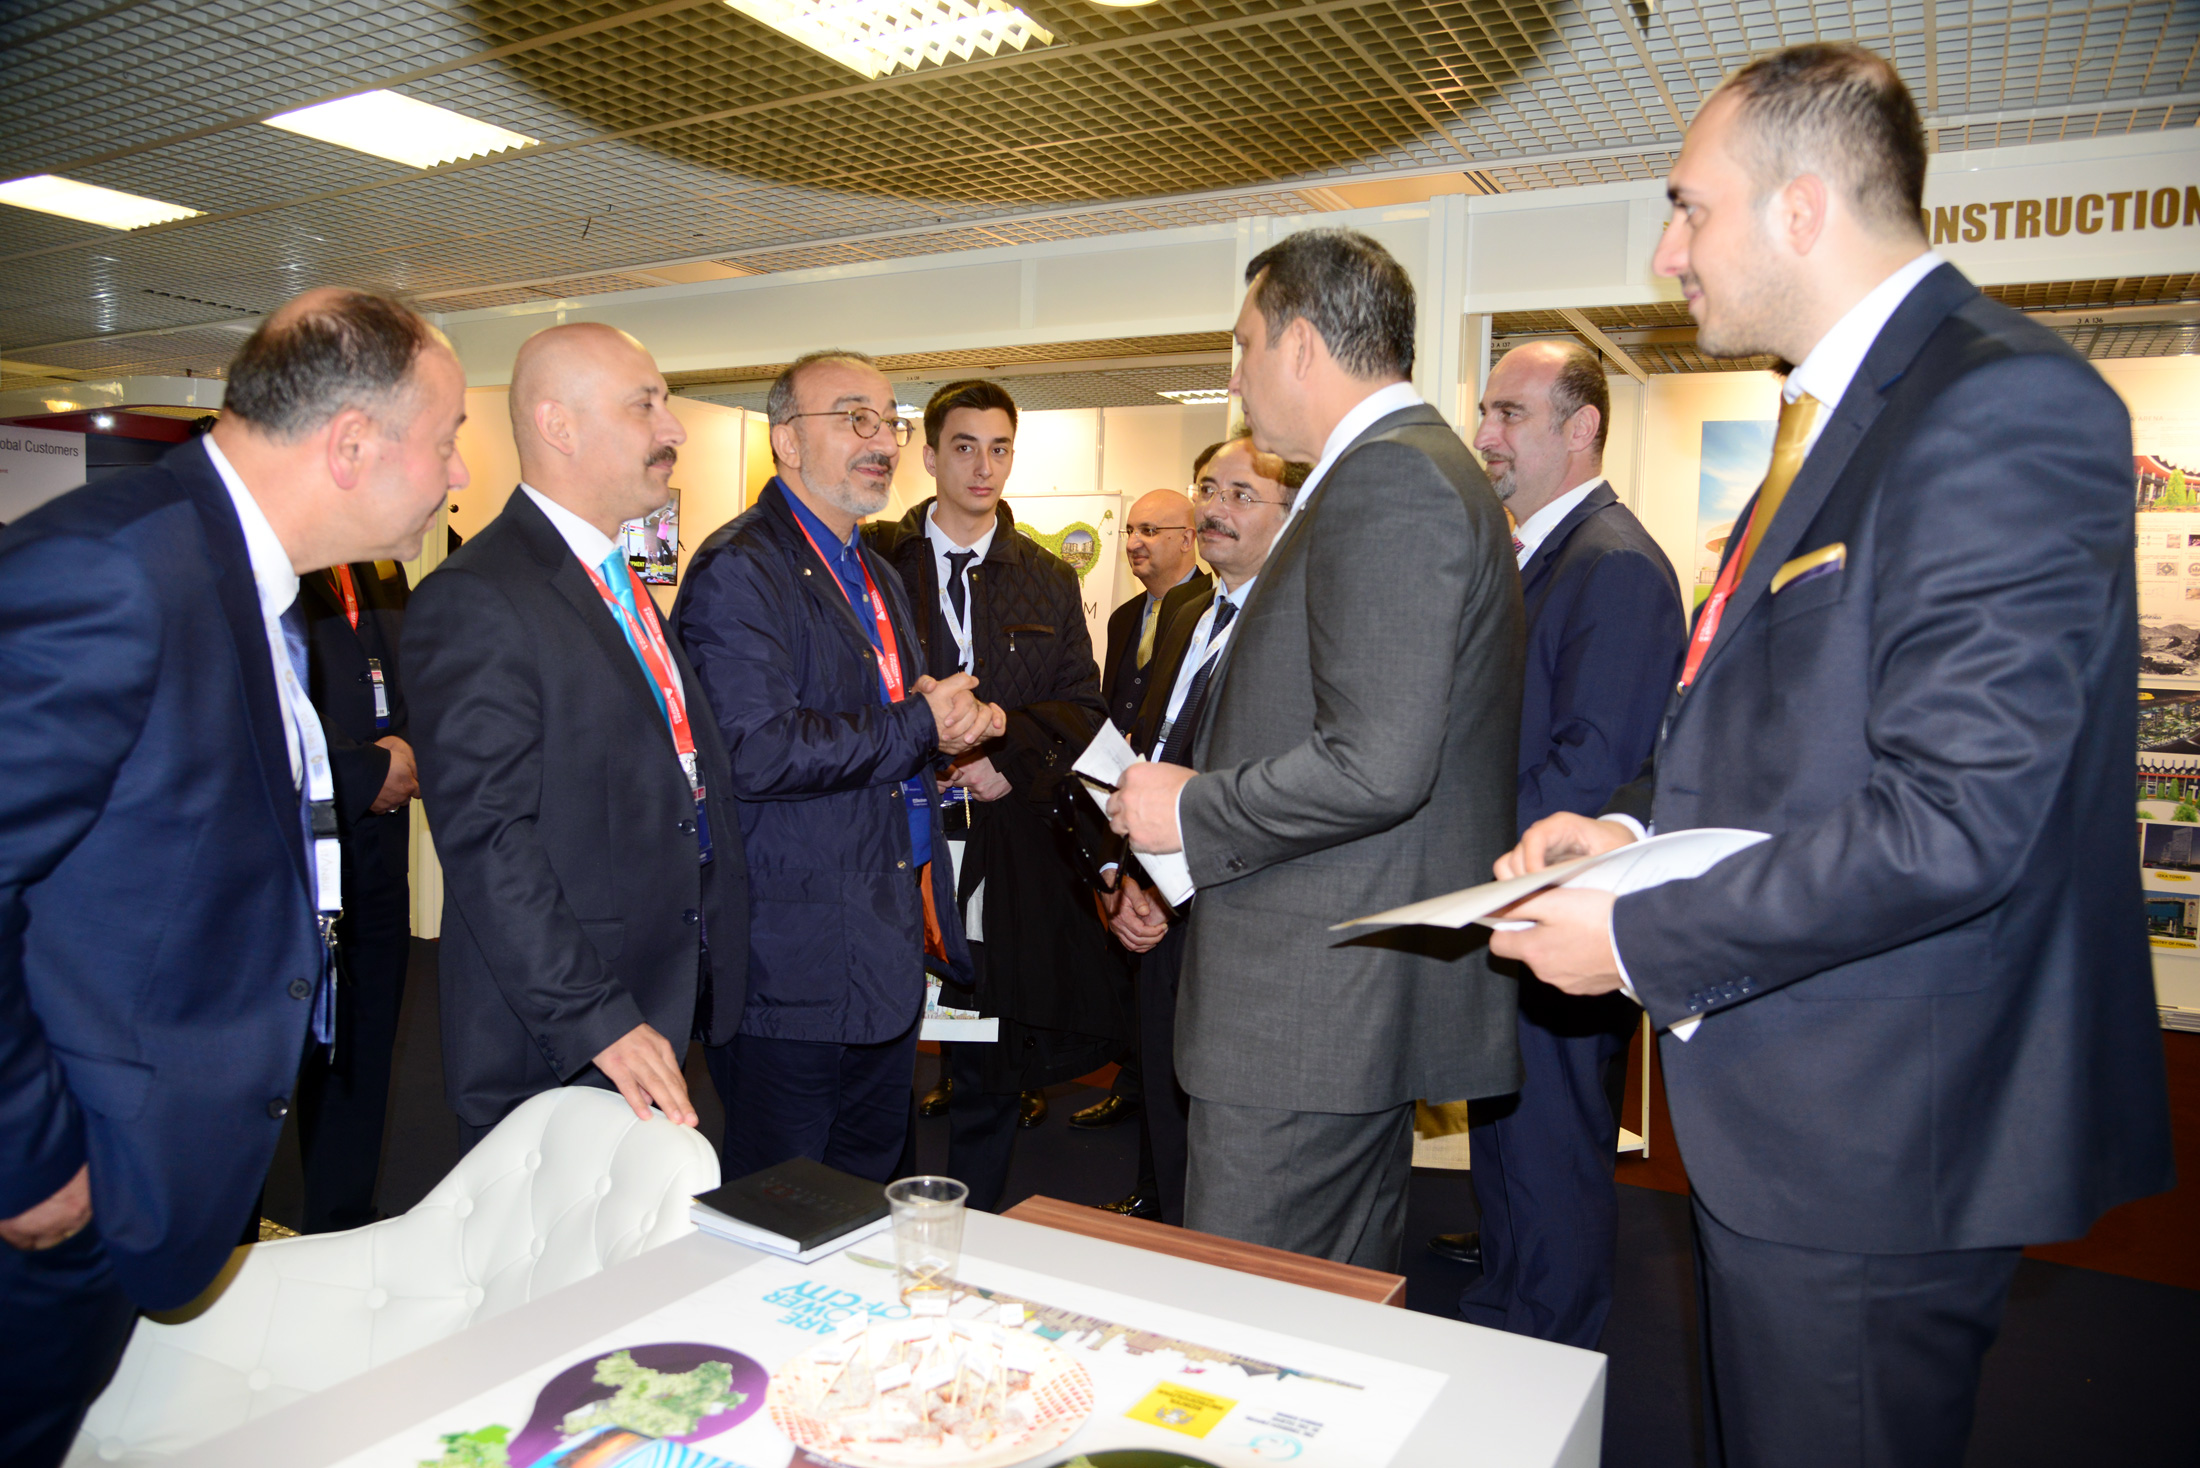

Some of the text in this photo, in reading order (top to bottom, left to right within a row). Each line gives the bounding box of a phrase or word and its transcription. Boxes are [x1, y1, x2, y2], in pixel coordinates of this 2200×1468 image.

[1921, 185, 2200, 245] NSTRUCTION
[0, 438, 79, 457] obal Customers
[762, 1290, 870, 1323] OWER
[780, 1280, 862, 1308] CITY
